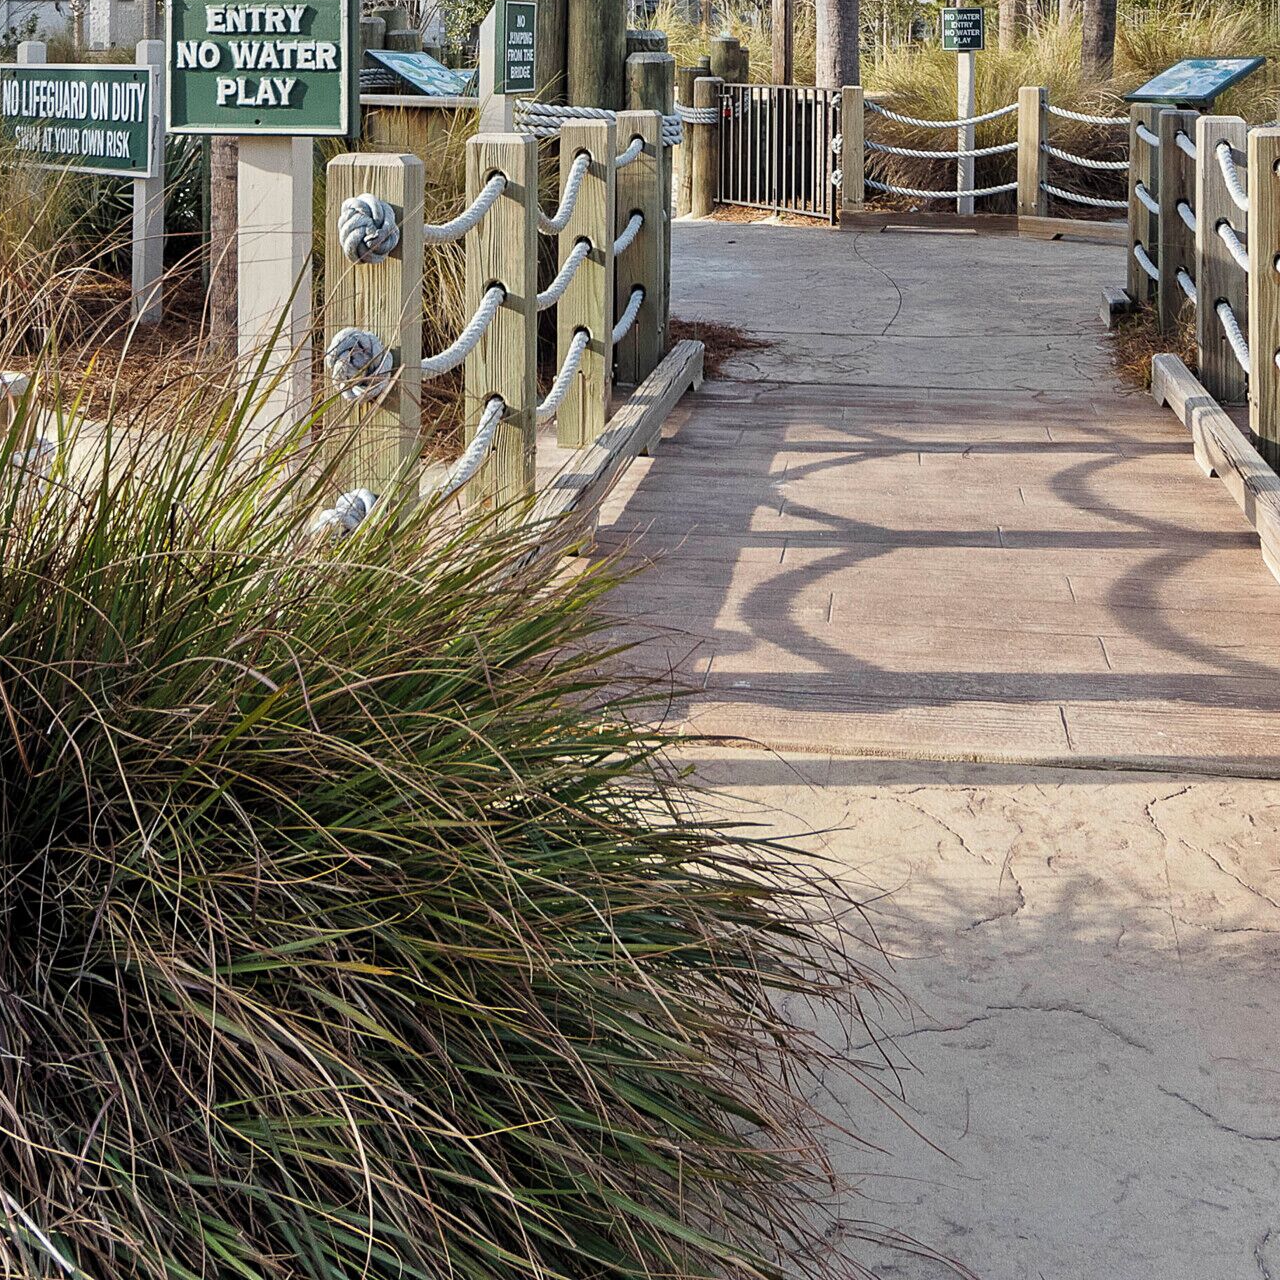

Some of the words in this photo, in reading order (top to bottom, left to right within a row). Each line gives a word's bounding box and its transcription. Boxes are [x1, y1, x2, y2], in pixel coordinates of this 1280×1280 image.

[205, 4, 307, 33] ENTRY
[517, 15, 525, 27] NO
[509, 32, 532, 44] JUMPING
[176, 40, 220, 69] NO
[228, 40, 337, 70] WATER
[508, 49, 522, 61] FROM
[524, 49, 533, 61] THE
[511, 66, 530, 78] BRIDGE
[2, 80, 19, 116] NO
[22, 80, 87, 120] LIFEGUARD
[91, 81, 108, 120] ON
[112, 82, 146, 122] DUTY
[216, 76, 297, 106] PLAY
[15, 126, 40, 151] SWIM
[42, 126, 54, 152] AT
[55, 127, 79, 155] YOUR
[81, 129, 104, 156] OWN
[106, 131, 130, 158] RISK
